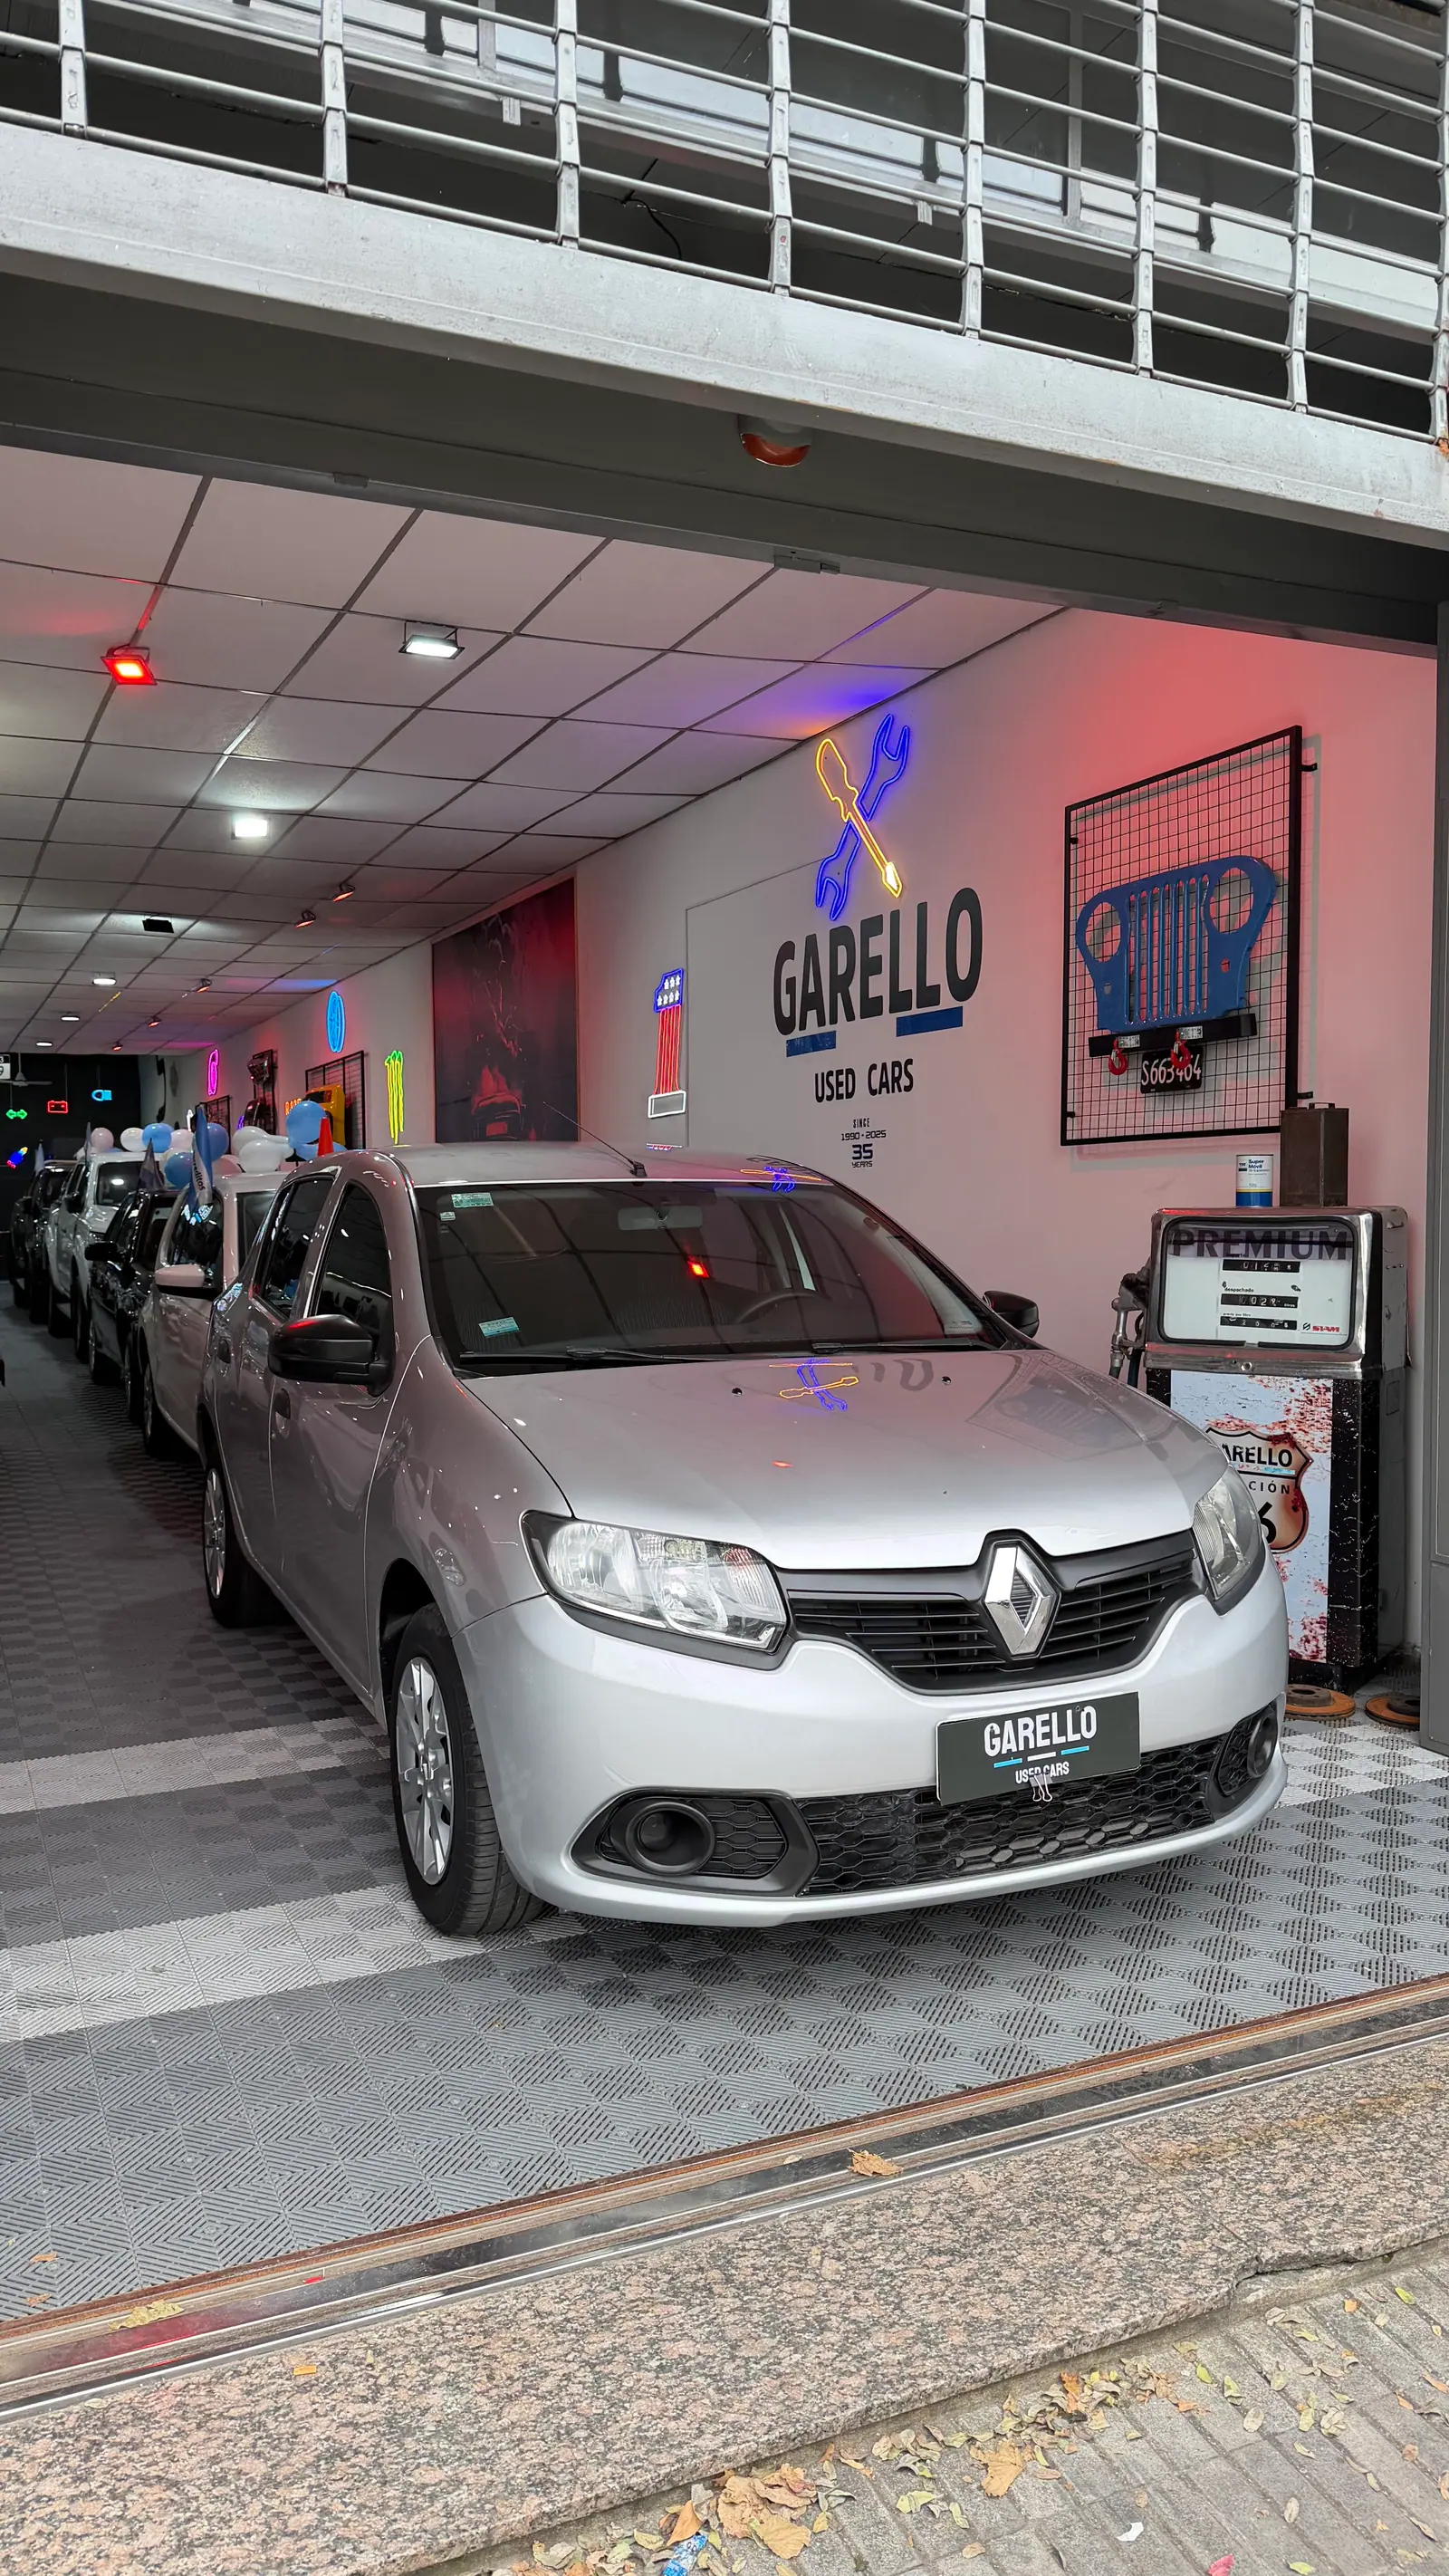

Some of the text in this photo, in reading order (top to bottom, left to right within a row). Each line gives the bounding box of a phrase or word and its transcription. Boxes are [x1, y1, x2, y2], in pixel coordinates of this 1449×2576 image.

[772, 887, 983, 1035] GARELLO
[814, 1059, 914, 1102] USED CARS
[841, 1129, 887, 1140] 1990 2025
[852, 1118, 870, 1129] SINCE
[851, 1143, 873, 1160] 35
[1173, 1229, 1348, 1260] PREMIUM
[1222, 1443, 1292, 1467] ARELLO
[1248, 1480, 1291, 1495] CIÓN
[984, 1706, 1098, 1757] GARELLO
[1015, 1761, 1070, 1784] USED CARS
